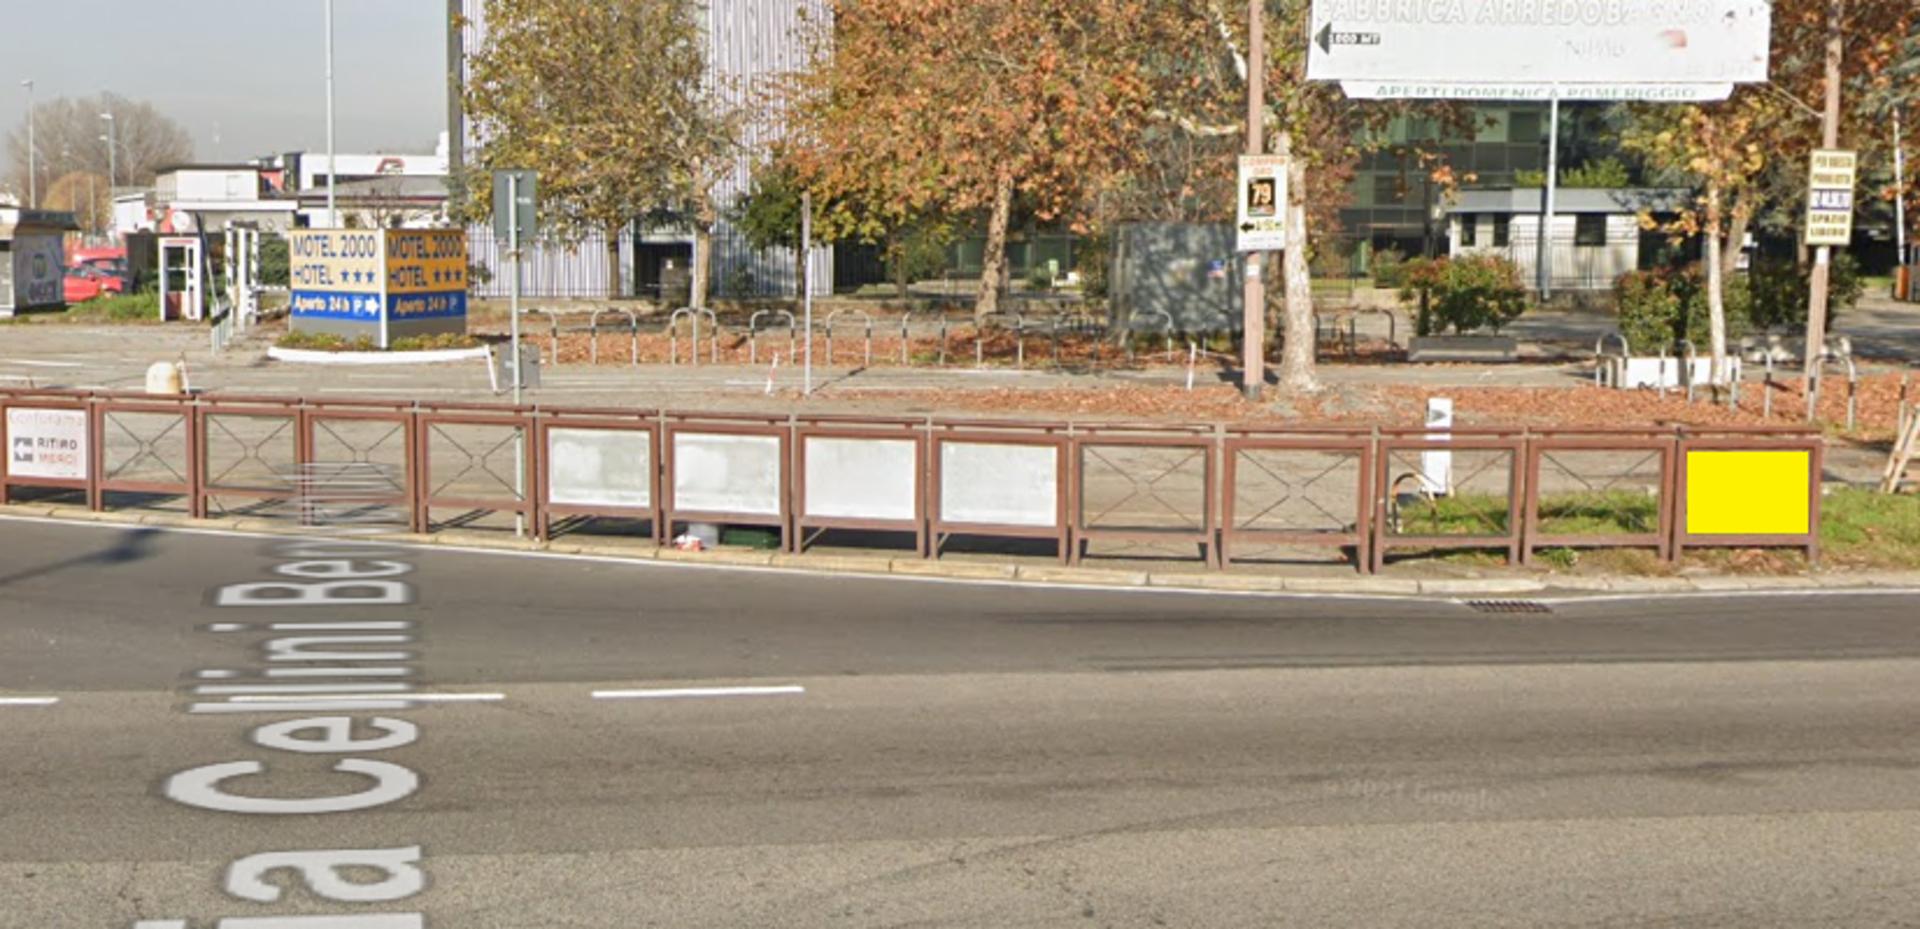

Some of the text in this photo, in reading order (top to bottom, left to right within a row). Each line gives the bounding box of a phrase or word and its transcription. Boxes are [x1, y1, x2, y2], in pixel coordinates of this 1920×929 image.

[1316, 0, 1465, 23] FABBRICA
[1375, 85, 1447, 97] APERTI
[1452, 86, 1558, 98] DOMENICA
[1251, 182, 1272, 204] 79
[293, 235, 376, 257] MOTEL 2000
[387, 234, 463, 259] MOTEL 2000
[294, 264, 334, 285] HOTEL
[388, 266, 427, 287] HOTEL
[294, 295, 326, 312] Aperto
[394, 297, 425, 315] Aperto
[38, 437, 77, 450] RITIRO
